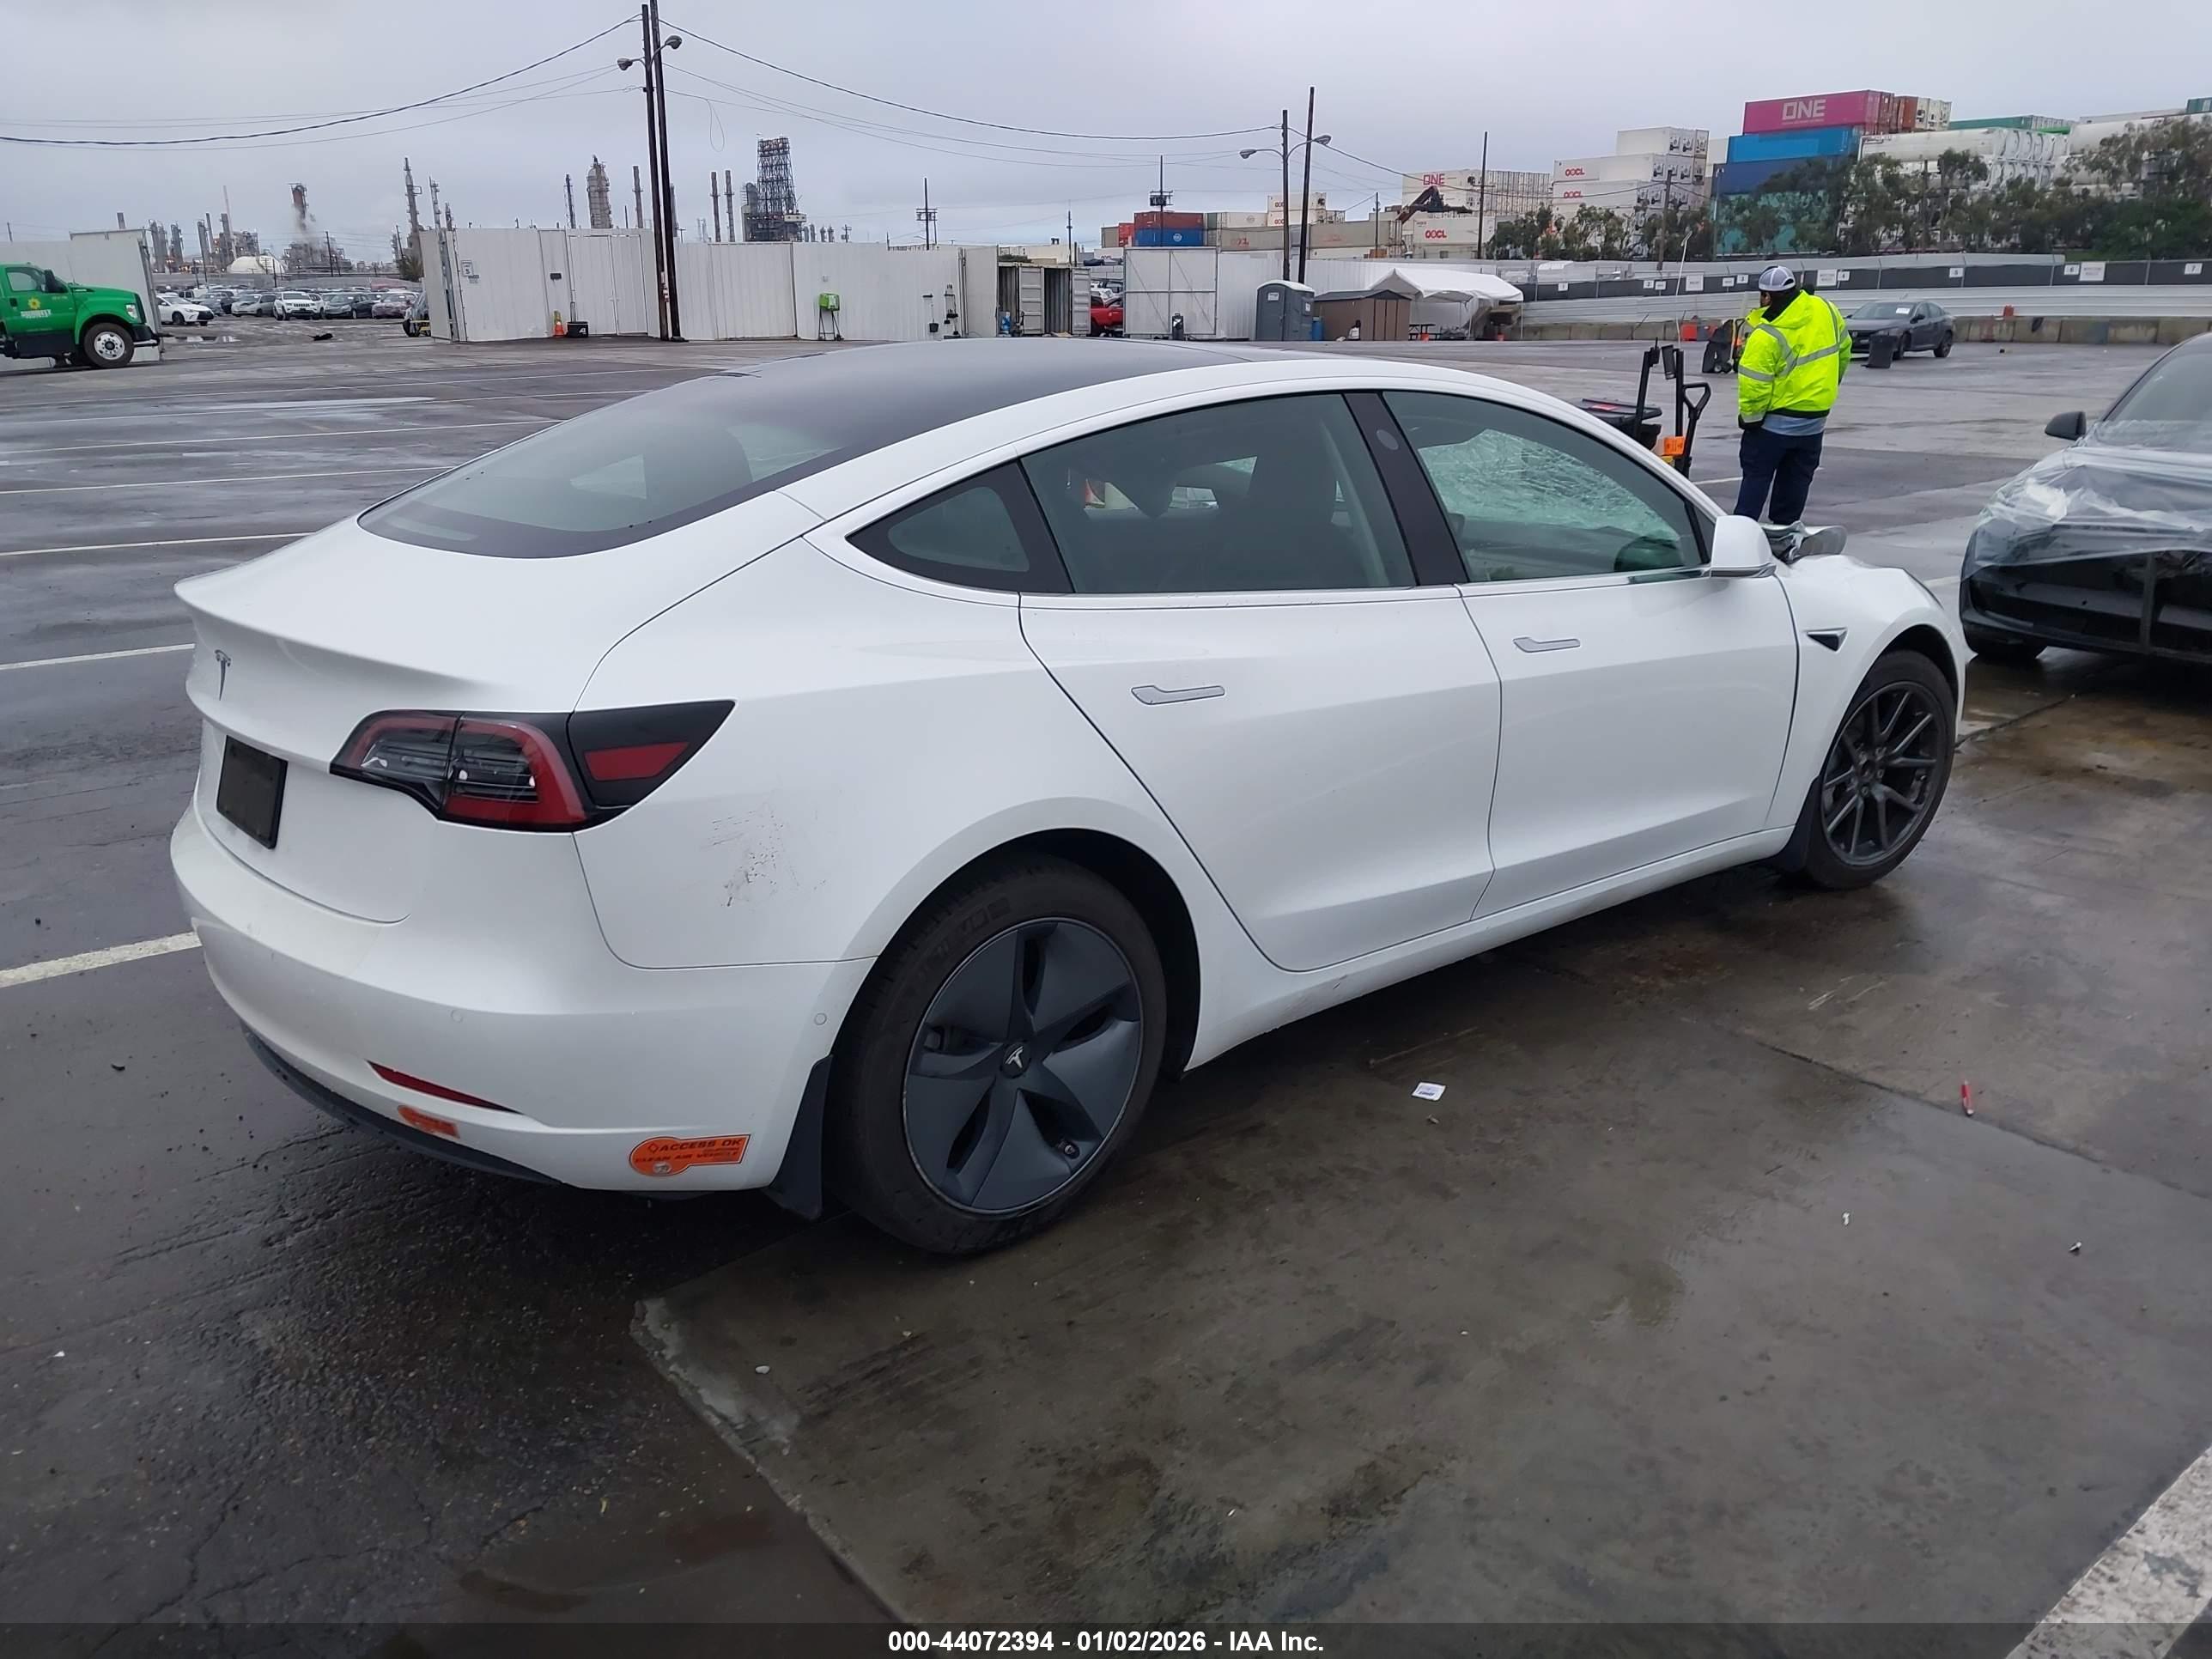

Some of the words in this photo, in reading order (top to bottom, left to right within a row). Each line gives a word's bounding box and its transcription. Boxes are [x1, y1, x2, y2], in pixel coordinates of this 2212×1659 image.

[1782, 99, 1826, 120] ONE
[1565, 167, 1585, 176] OOCL
[1423, 173, 1445, 185] ONE
[1425, 228, 1448, 239] OOCL
[659, 1139, 716, 1152] ACCESS
[722, 1139, 743, 1147] OK
